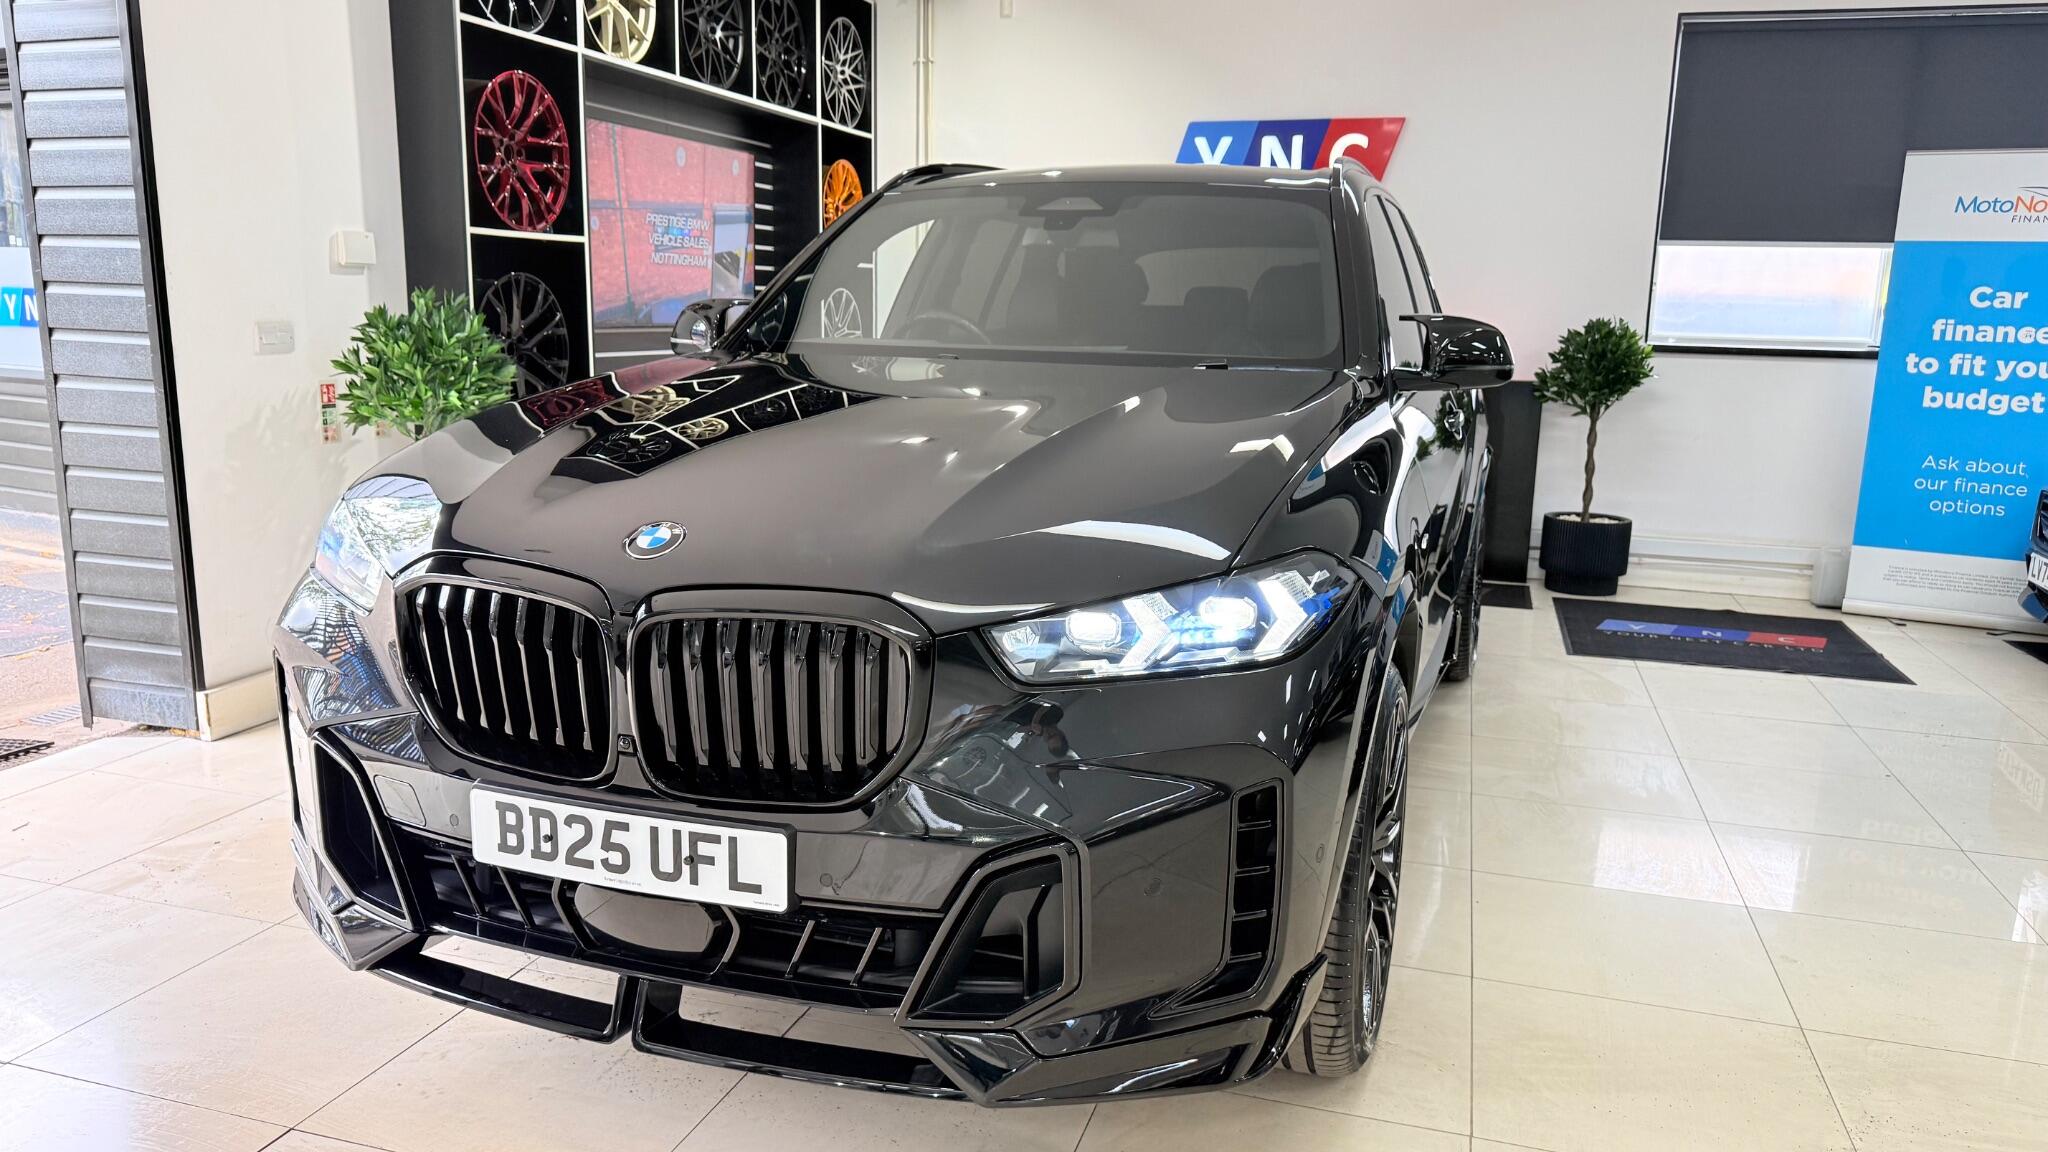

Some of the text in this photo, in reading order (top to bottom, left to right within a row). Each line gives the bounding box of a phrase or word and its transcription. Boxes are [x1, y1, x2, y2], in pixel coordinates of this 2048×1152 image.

[645, 212, 710, 231] PRESTIGE BMW
[648, 232, 710, 249] VEHICLE SALES
[650, 252, 707, 267] NOTTINGHAM
[1969, 286, 2029, 309] Car
[1905, 352, 1939, 375] to
[1949, 353, 1986, 377] fit
[1922, 385, 2046, 416] budget
[1921, 455, 2027, 475] Ask about
[1914, 477, 2028, 497] our finance
[1929, 499, 2005, 516] options
[495, 800, 763, 895] BD25 UFL
